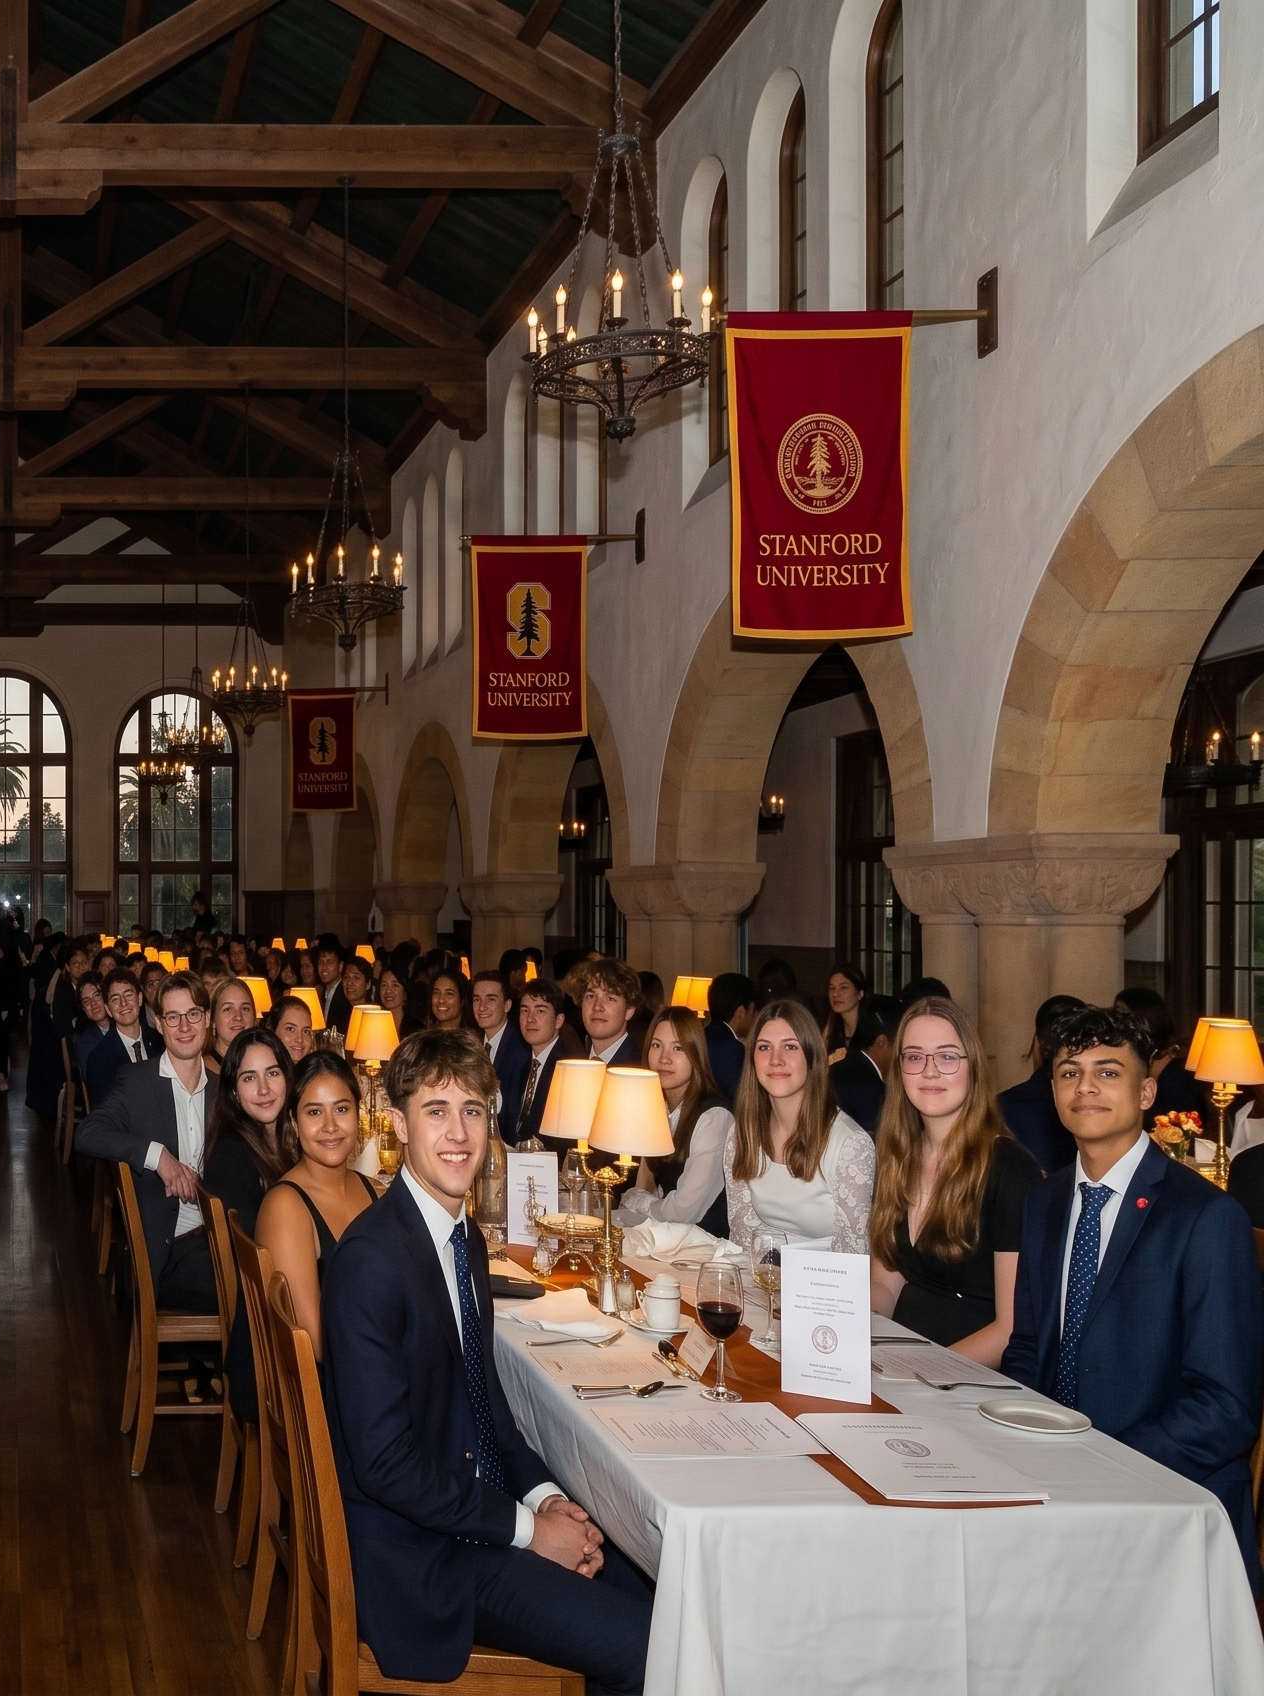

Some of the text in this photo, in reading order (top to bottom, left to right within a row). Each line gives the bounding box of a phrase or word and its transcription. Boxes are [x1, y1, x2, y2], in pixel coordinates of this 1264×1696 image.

[759, 533, 882, 556] STANFORD
[756, 562, 890, 587] UNIVERSITY
[488, 671, 570, 688] STANFORD
[487, 691, 573, 707] UNIVERSITY
[298, 772, 348, 782] STANFORD
[297, 783, 349, 793] UNIVERSITY
